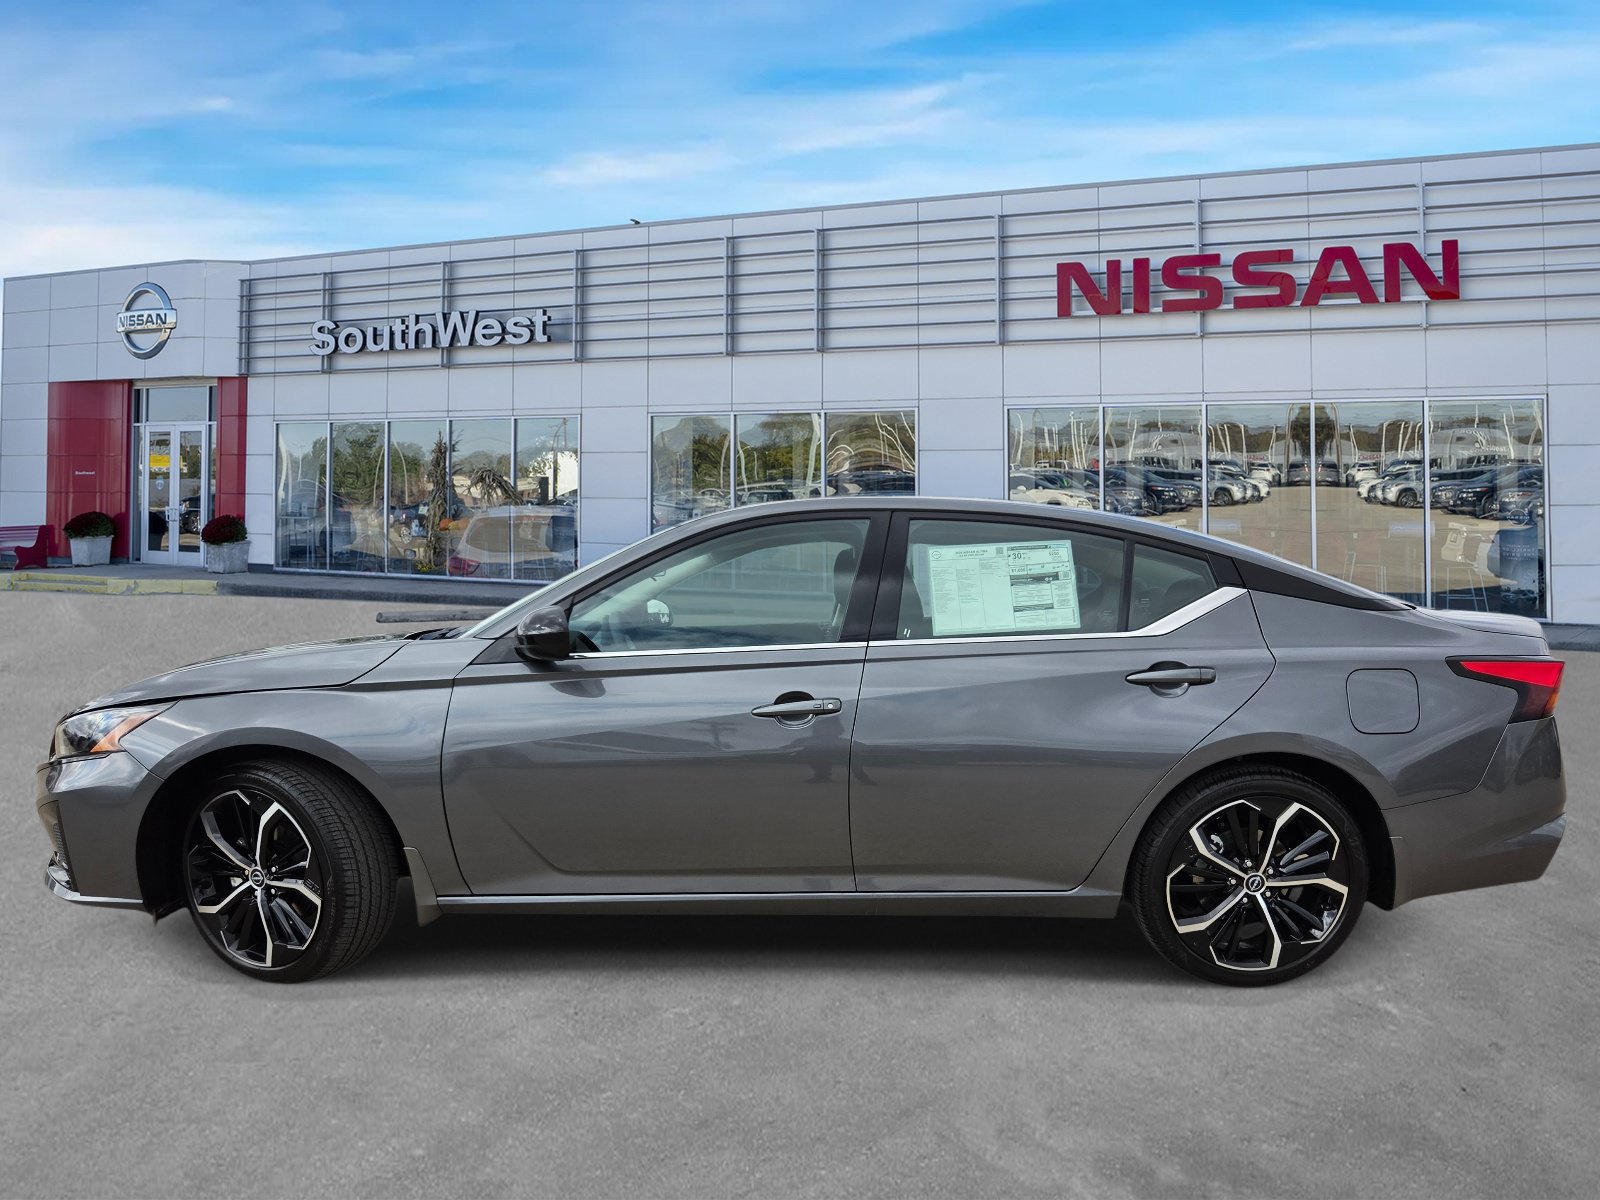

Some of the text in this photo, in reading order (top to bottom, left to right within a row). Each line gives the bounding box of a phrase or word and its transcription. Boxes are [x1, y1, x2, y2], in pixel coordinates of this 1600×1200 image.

[1057, 239, 1460, 317] NISSAN
[119, 312, 167, 328] NISSAN
[310, 308, 551, 356] SouthWest
[1011, 552, 1022, 560] 30
